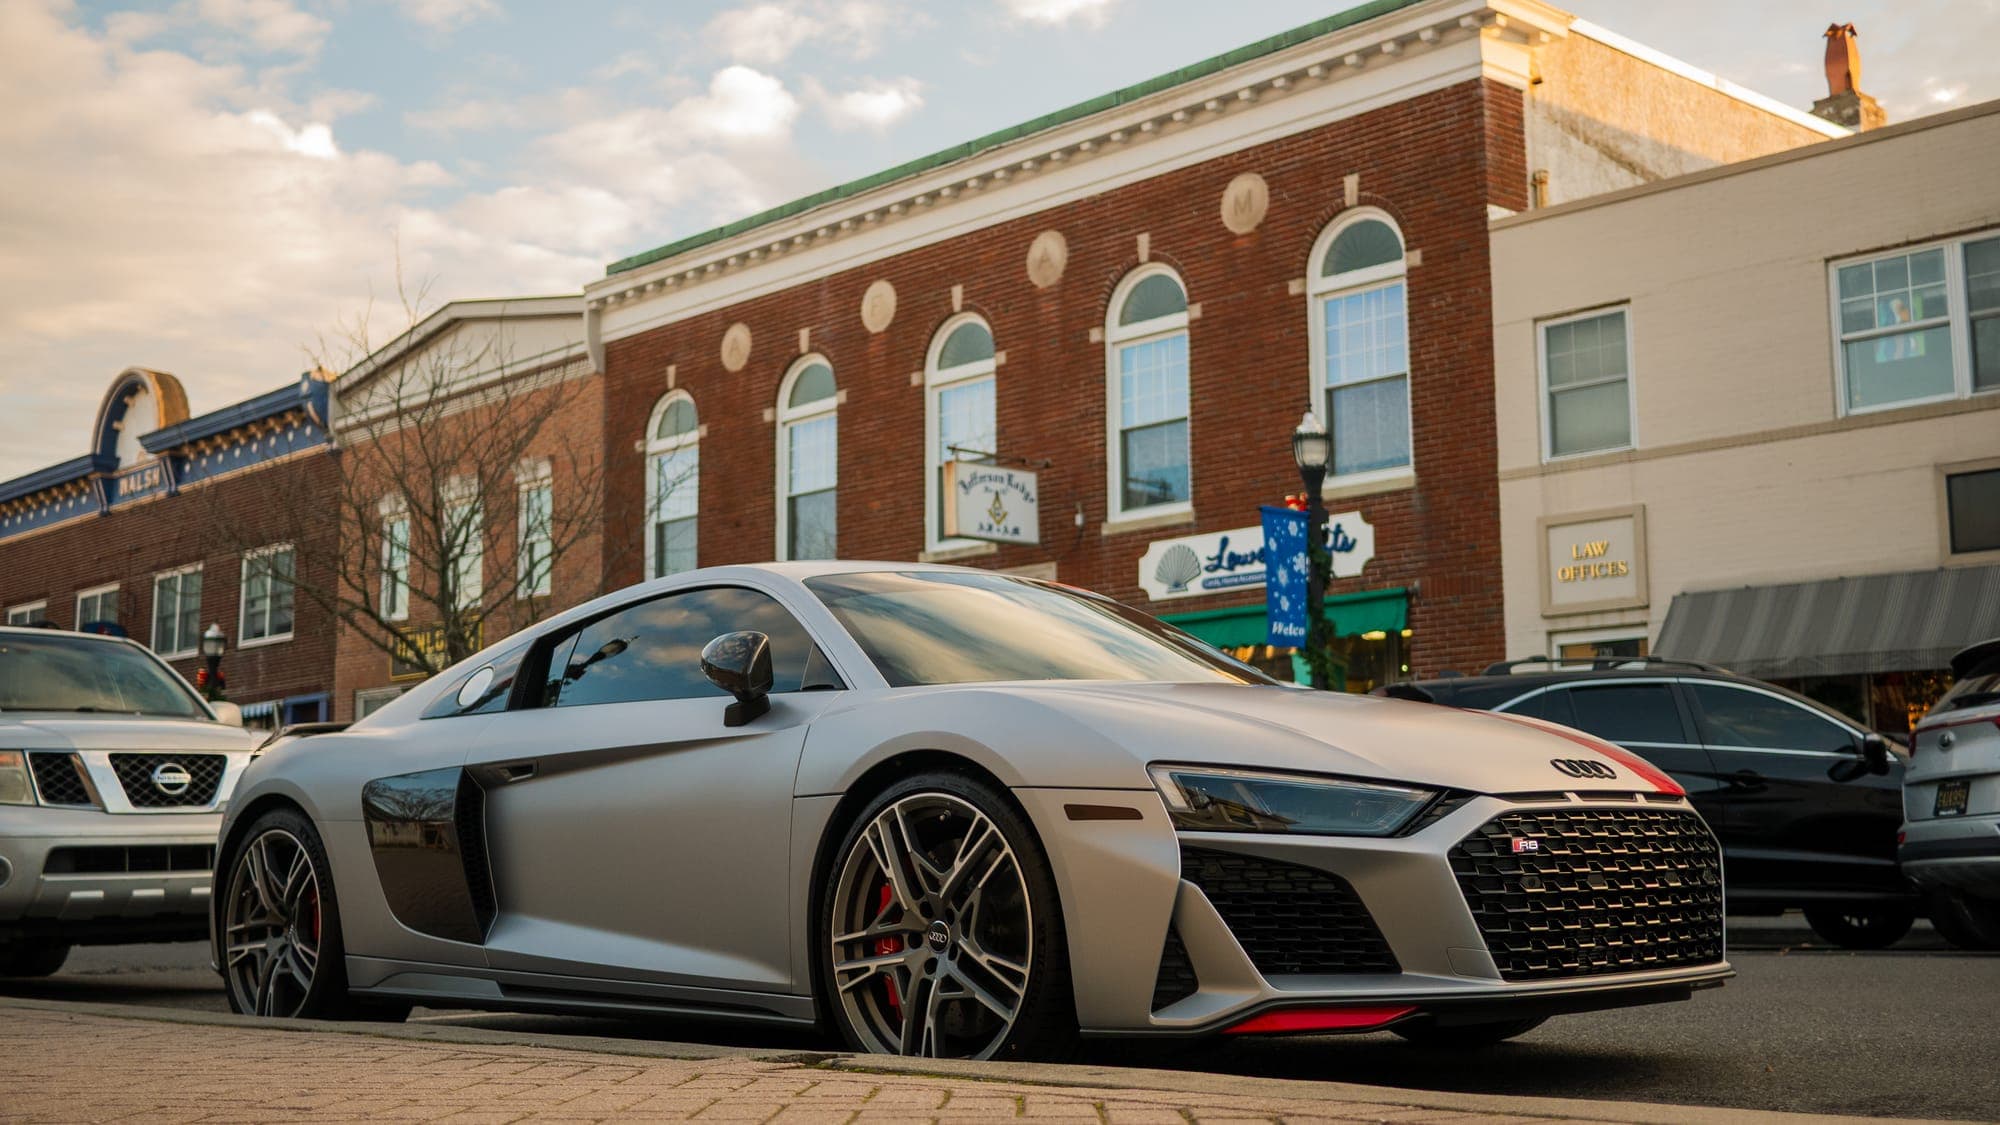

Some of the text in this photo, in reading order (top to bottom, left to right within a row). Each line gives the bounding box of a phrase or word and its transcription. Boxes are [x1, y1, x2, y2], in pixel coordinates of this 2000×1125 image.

[1037, 246, 1054, 270] A
[1233, 188, 1253, 216] M
[119, 466, 161, 497] WALSH
[1571, 540, 1609, 560] LAW
[1557, 560, 1629, 583] OFFICES
[1272, 620, 1306, 637] Welco
[1518, 840, 1538, 850] R8
